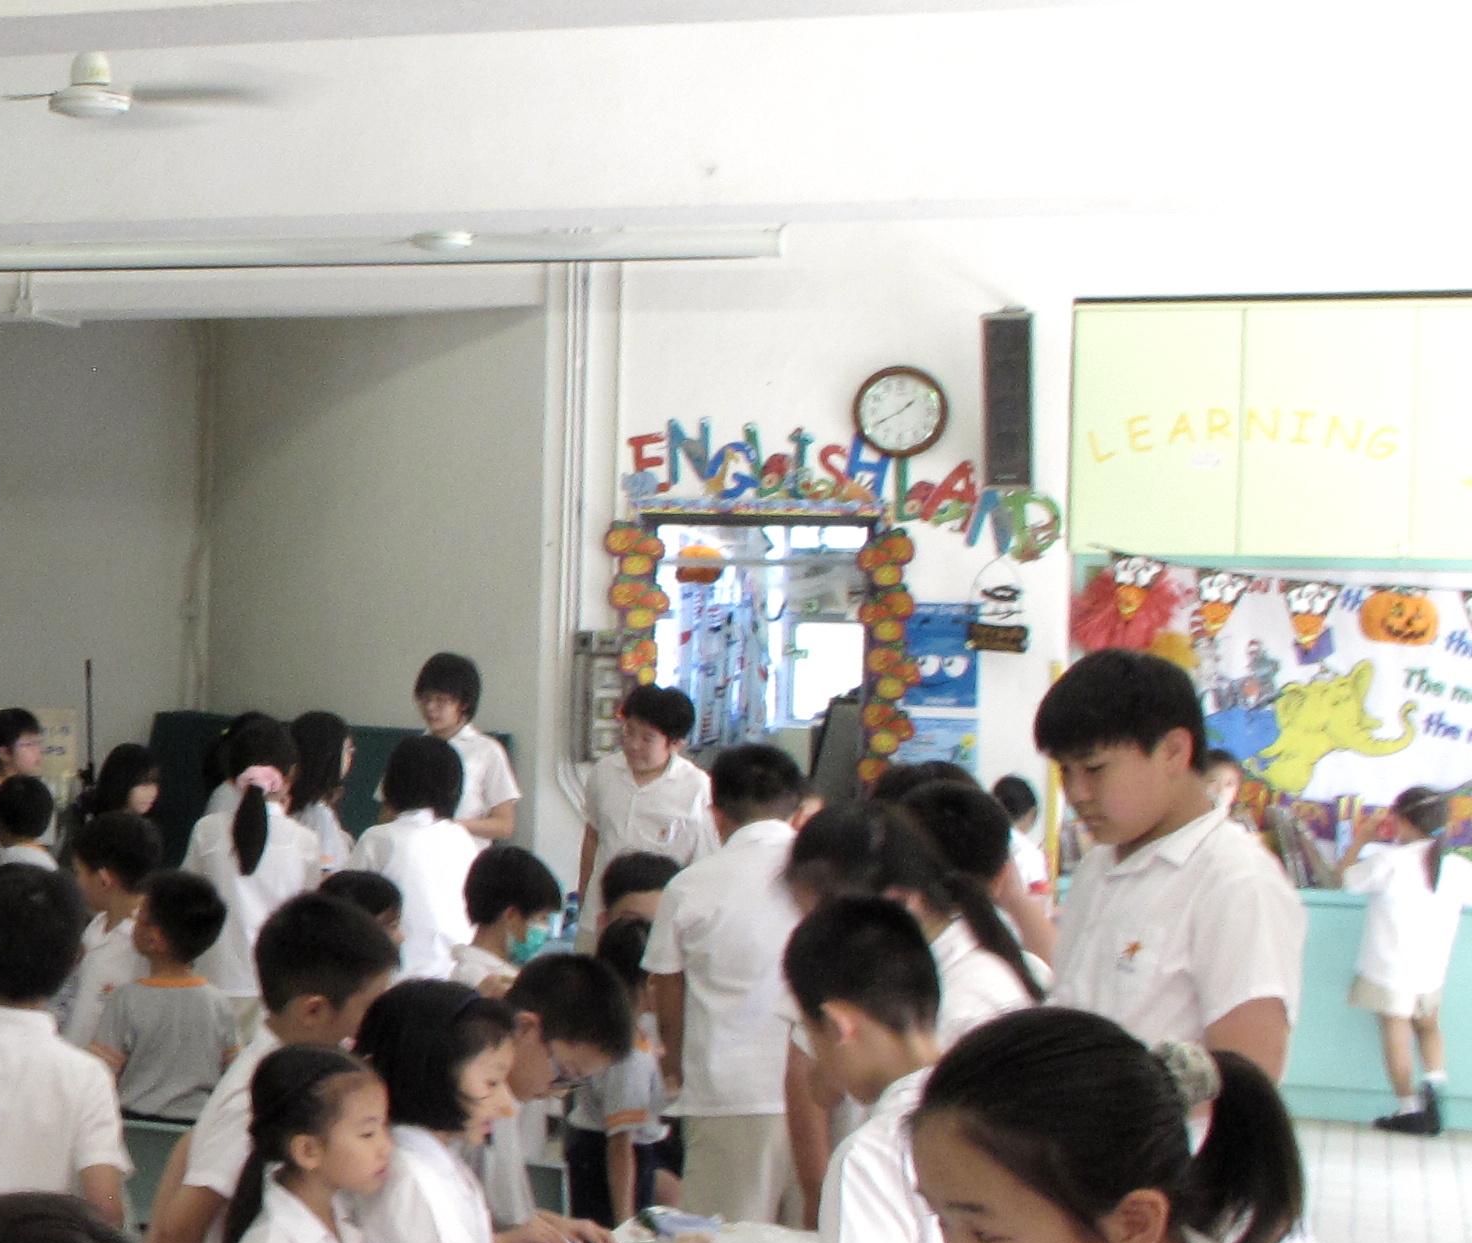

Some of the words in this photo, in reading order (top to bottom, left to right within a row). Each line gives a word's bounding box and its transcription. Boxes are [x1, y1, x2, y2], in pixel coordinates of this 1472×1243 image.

[1087, 407, 1400, 463] LEARNING
[624, 416, 892, 500] ENGLISH
[889, 457, 1064, 564] LAND
